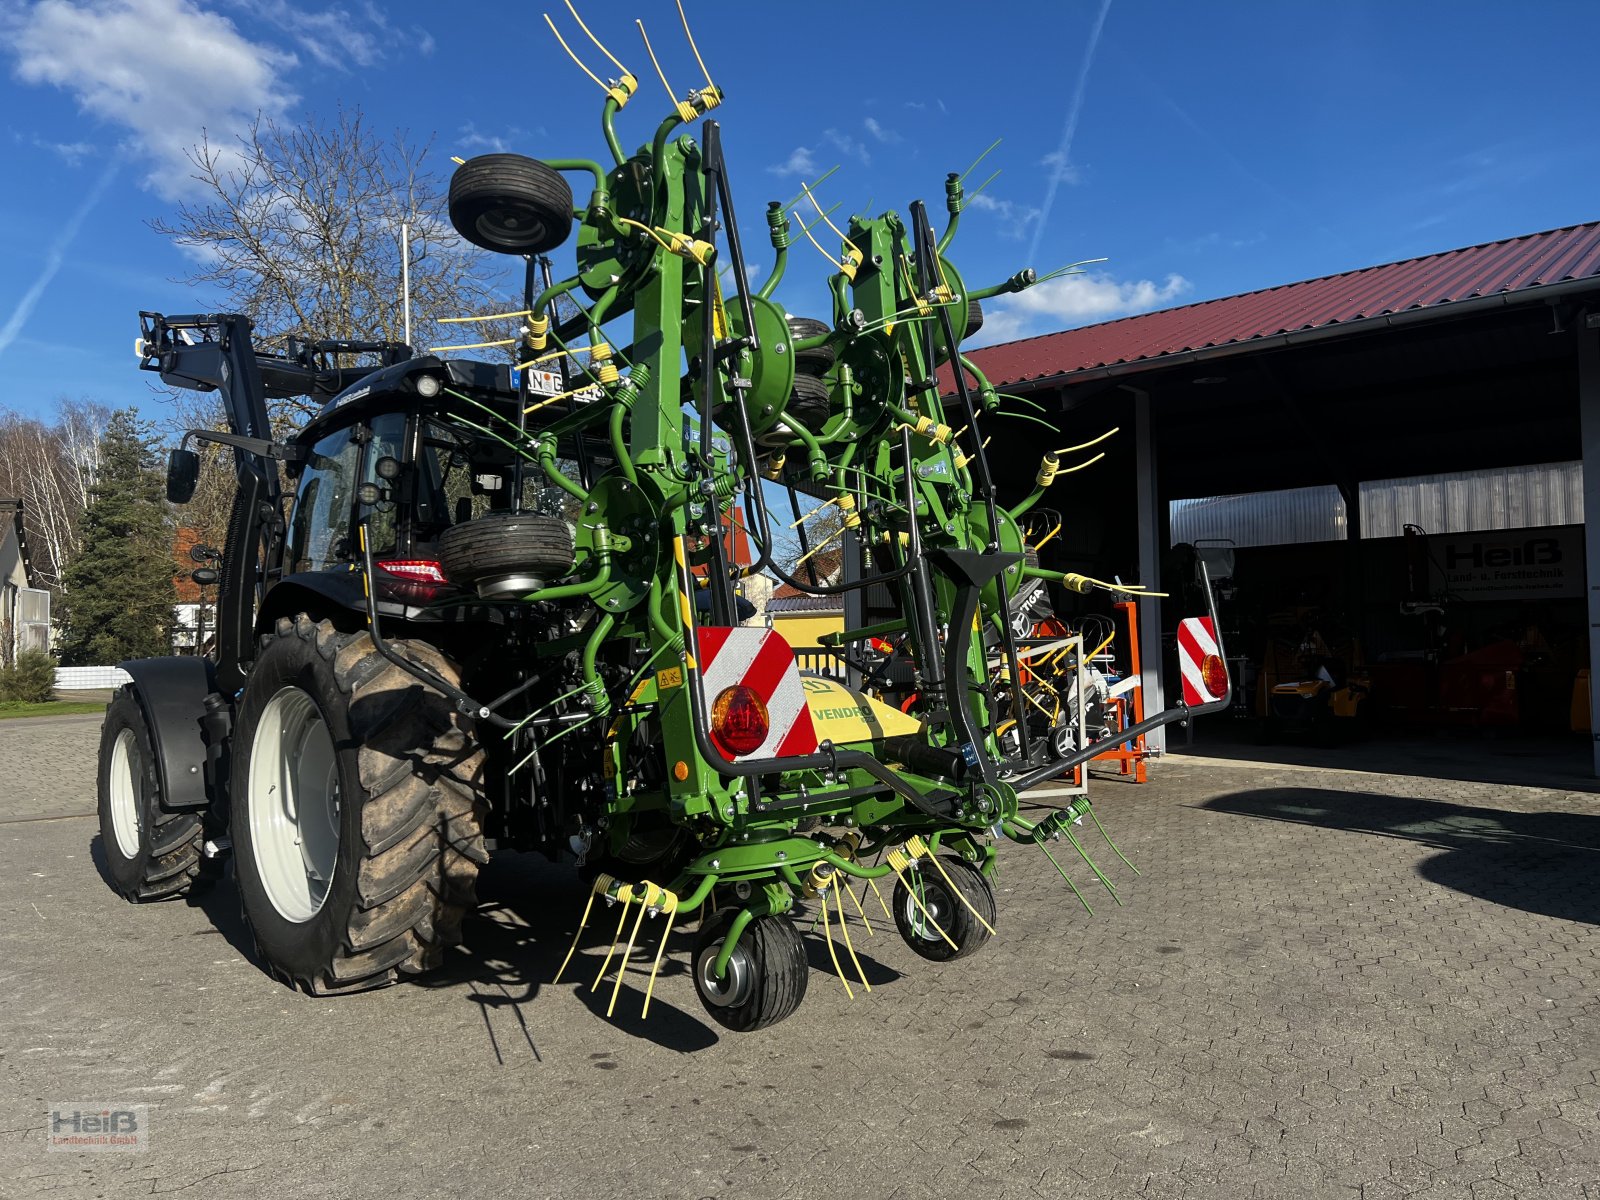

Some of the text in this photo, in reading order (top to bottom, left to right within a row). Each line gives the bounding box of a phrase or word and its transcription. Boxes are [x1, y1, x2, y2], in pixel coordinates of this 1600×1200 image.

[1446, 538, 1562, 569] Heiß
[1448, 571, 1477, 583] Land-
[1019, 589, 1045, 612] TIGA
[813, 705, 872, 720] VENDRO
